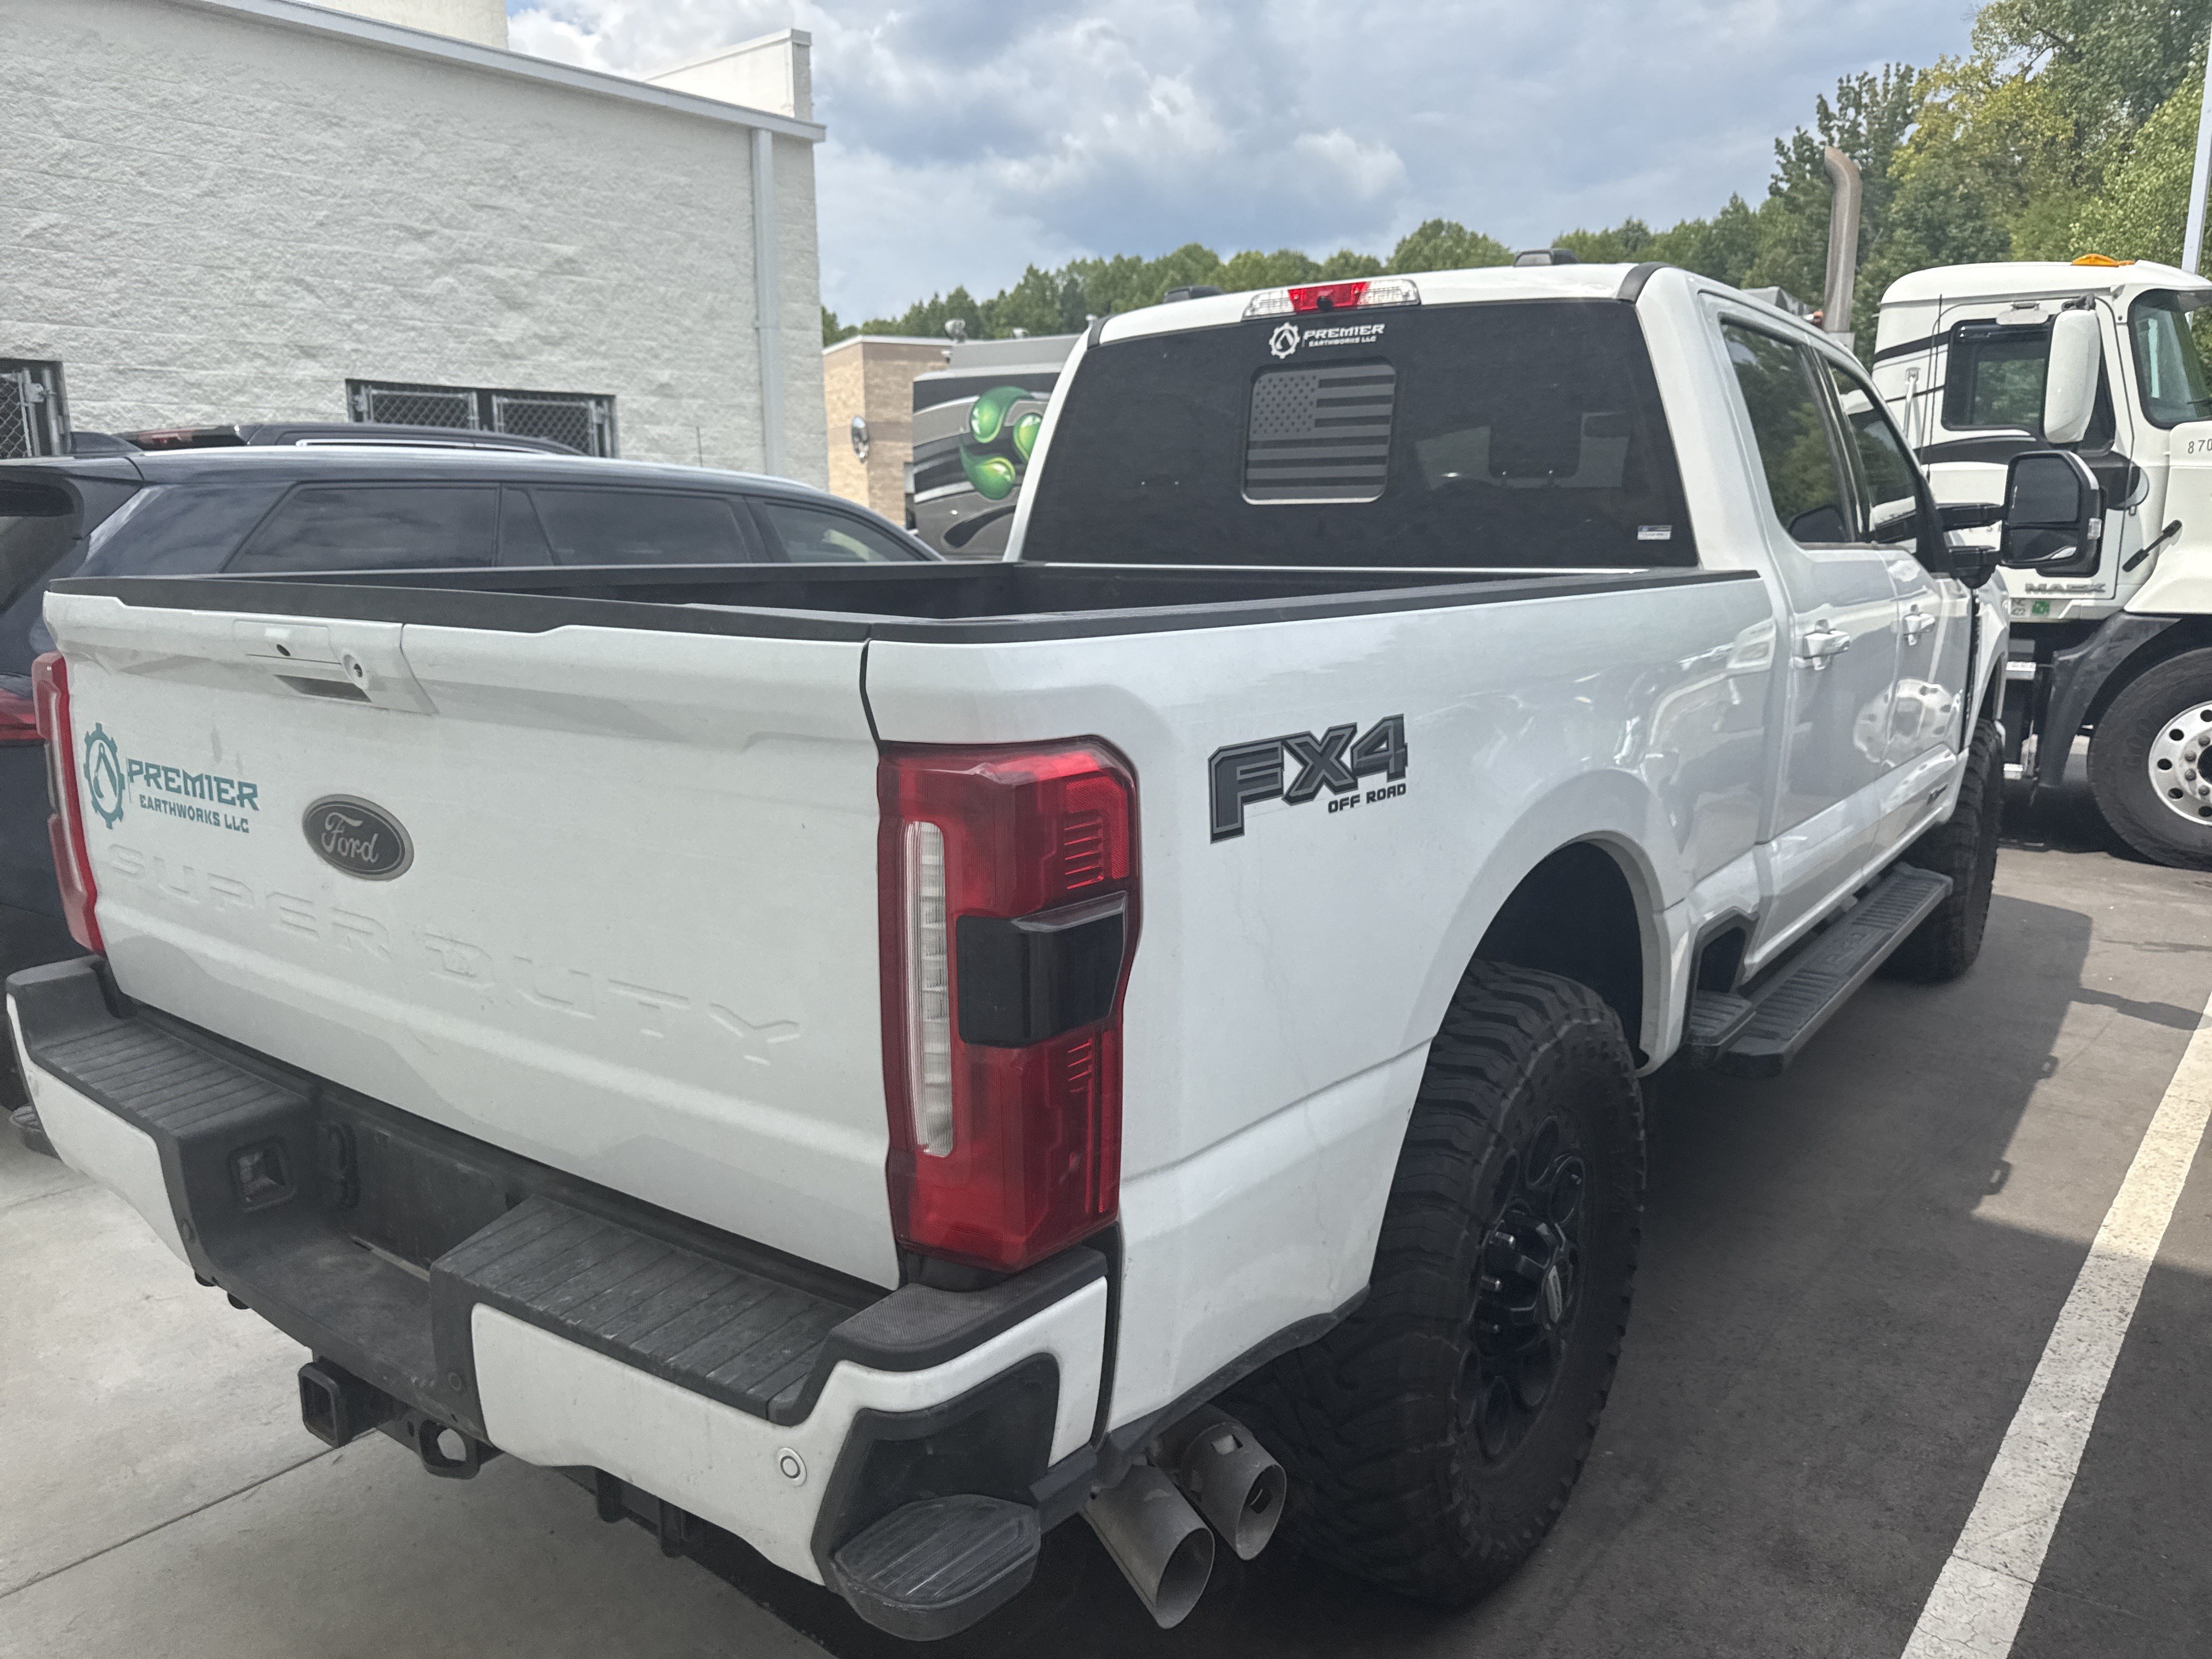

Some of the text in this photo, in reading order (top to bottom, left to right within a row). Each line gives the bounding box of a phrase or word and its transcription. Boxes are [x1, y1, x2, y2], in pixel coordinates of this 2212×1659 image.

[1303, 323, 1386, 340] PREMIER
[2025, 583, 2106, 594] MACK
[127, 758, 260, 811] PREMIER
[1208, 714, 1408, 844] FX4
[1328, 783, 1406, 814] OFF ROAD
[139, 794, 250, 833] EARTHWORKS LLC
[321, 811, 381, 864] Ford
[110, 843, 393, 966] SUPER
